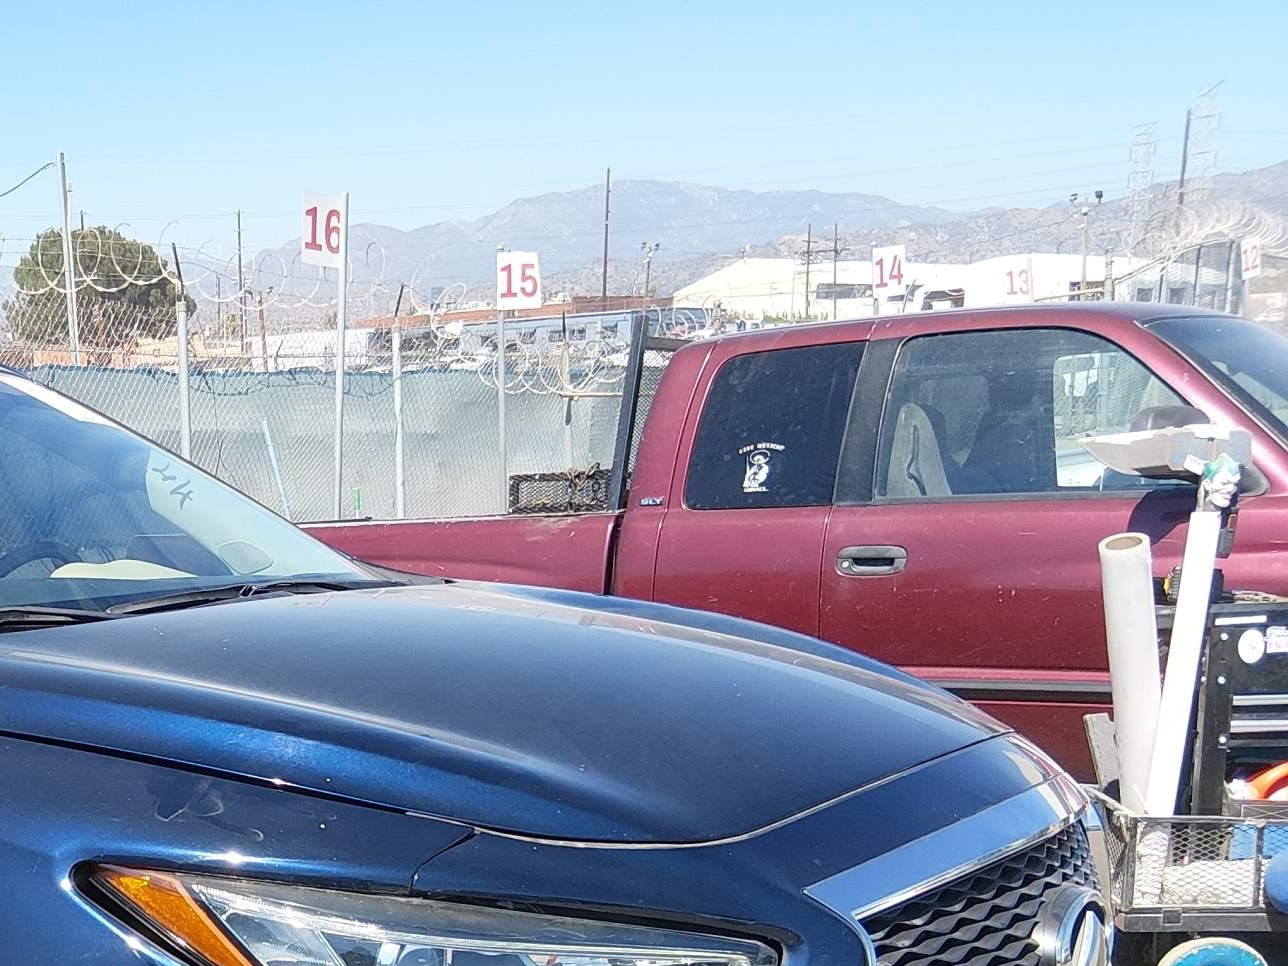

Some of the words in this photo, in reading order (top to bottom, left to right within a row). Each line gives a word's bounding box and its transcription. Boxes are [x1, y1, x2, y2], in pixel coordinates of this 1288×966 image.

[305, 206, 340, 254] 16
[875, 255, 904, 288] 14
[1242, 245, 1259, 272] 12
[500, 263, 538, 298] 15
[1005, 269, 1030, 296] 13
[640, 497, 664, 505] SLT
